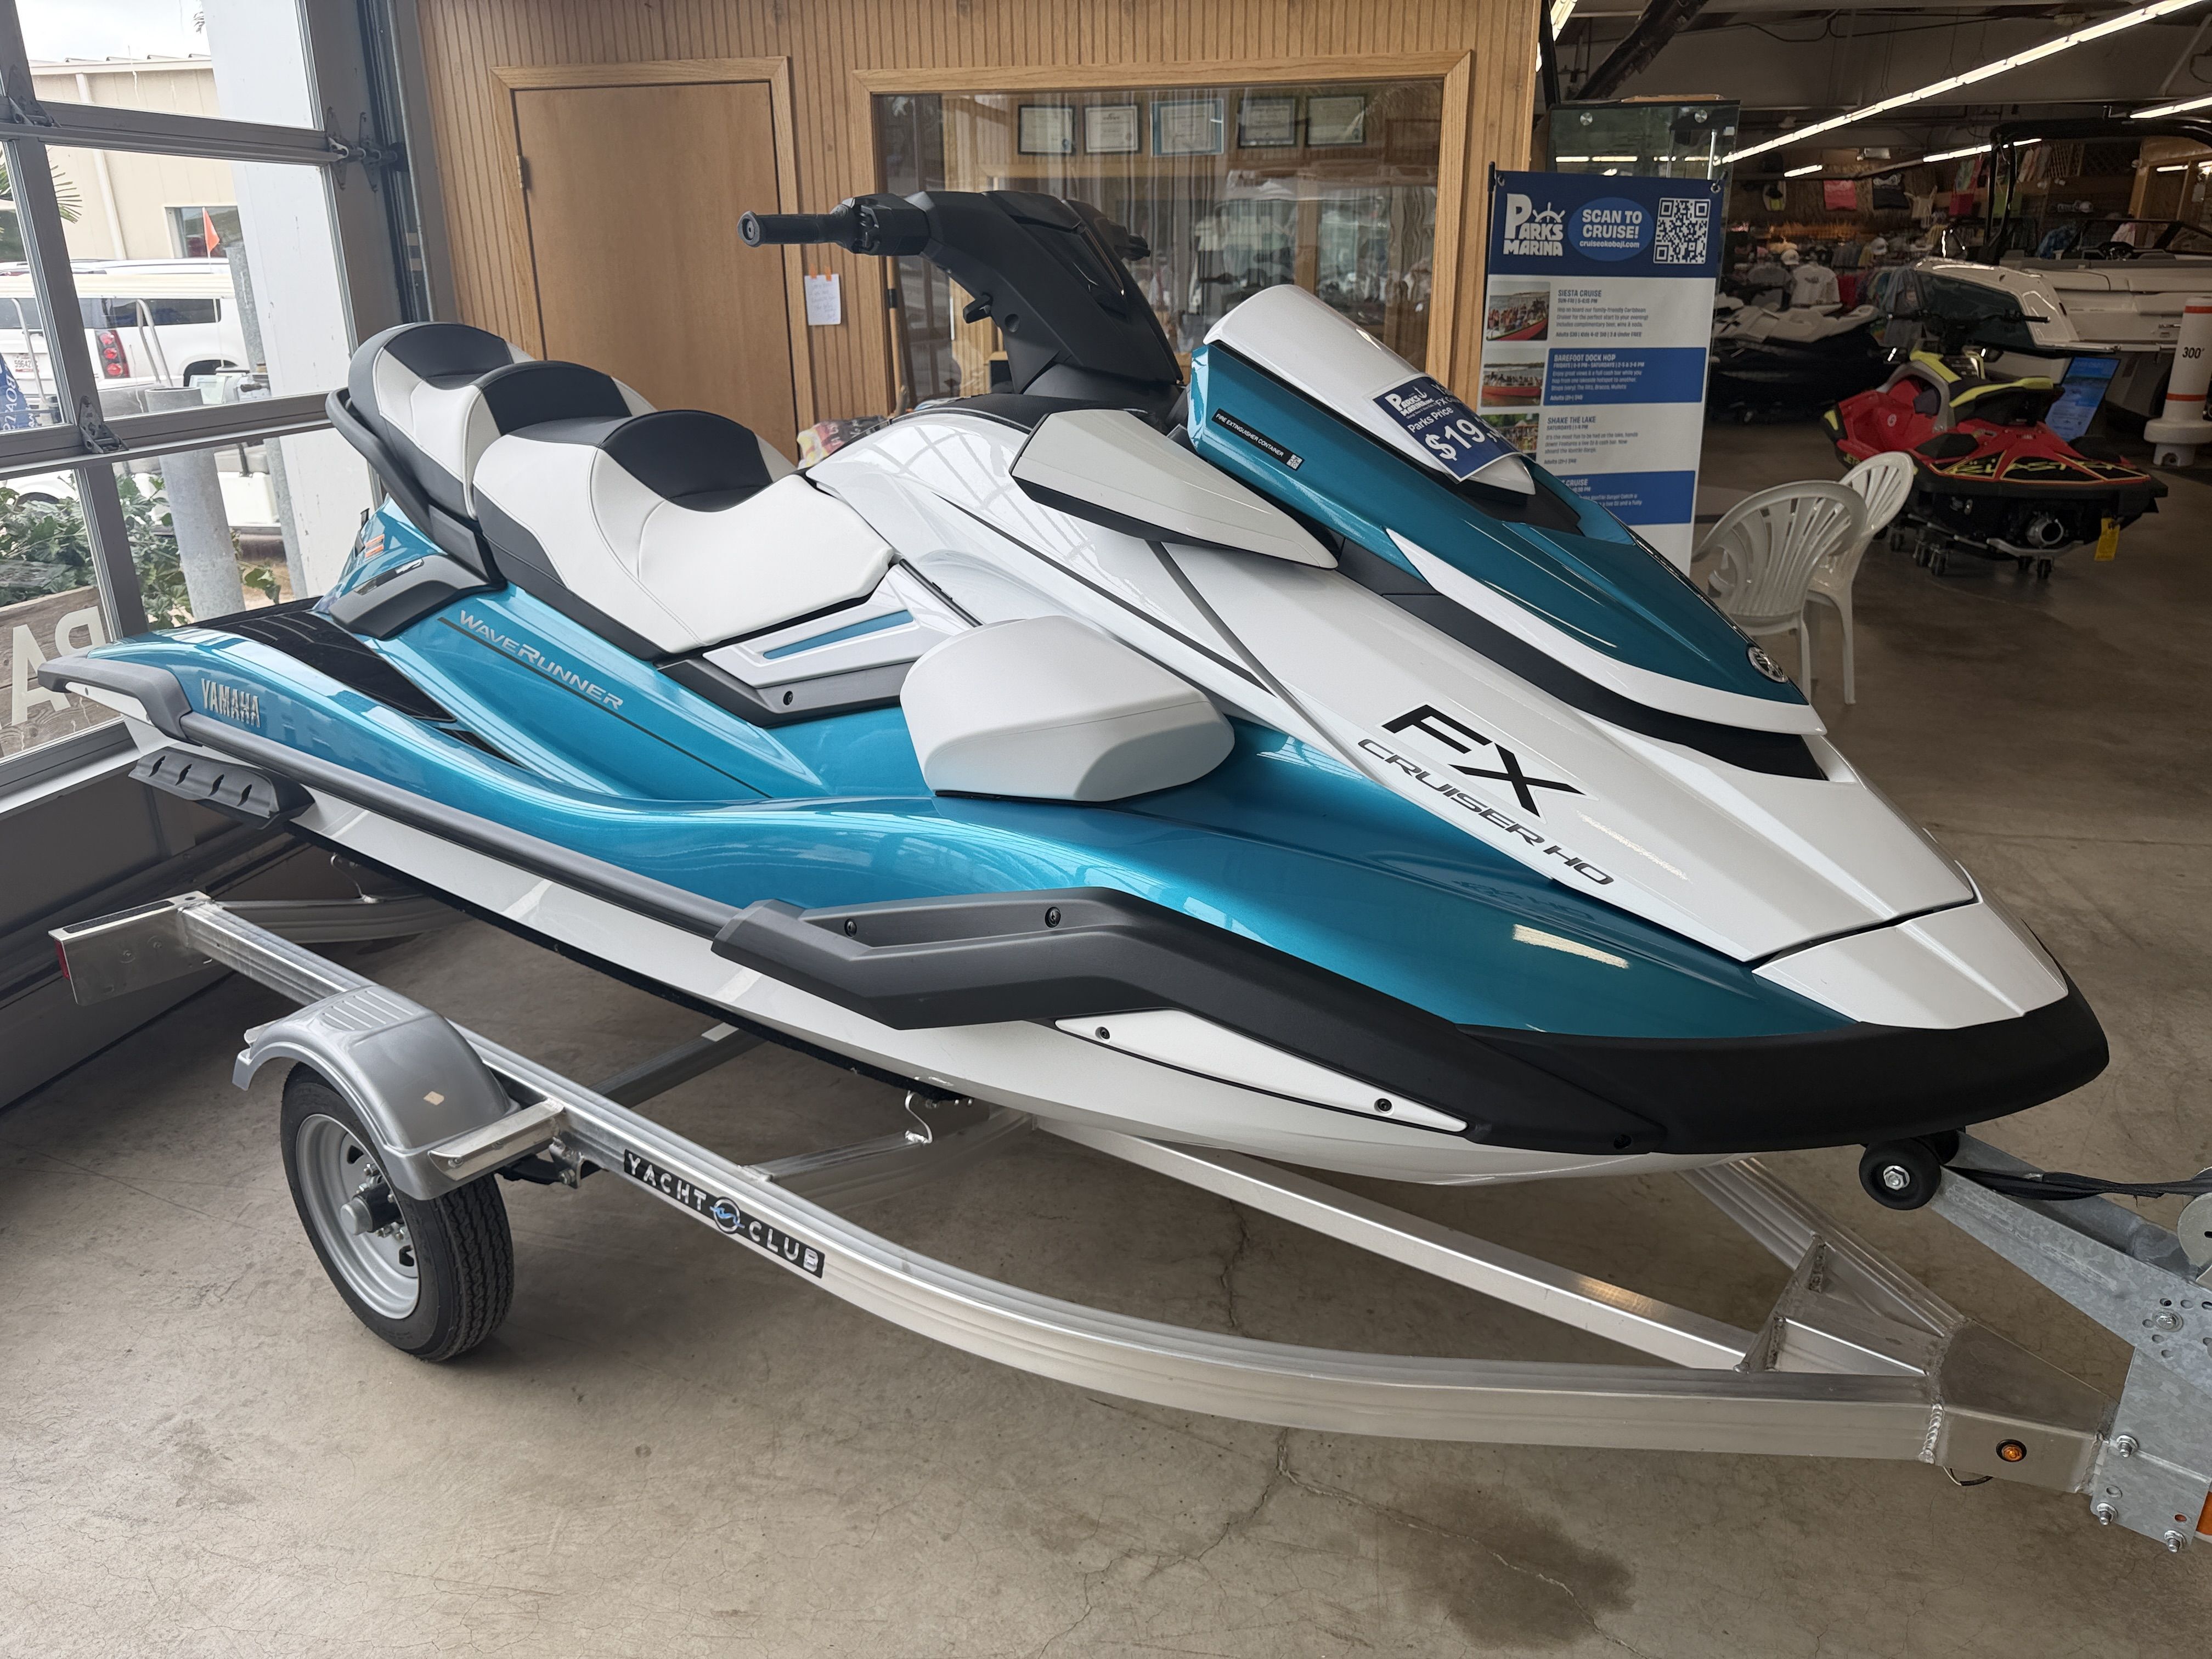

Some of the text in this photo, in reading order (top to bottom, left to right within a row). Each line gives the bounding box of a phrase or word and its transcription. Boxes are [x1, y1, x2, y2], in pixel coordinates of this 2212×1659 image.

[1504, 193, 1563, 240] PARKS
[1582, 209, 1642, 224] SCAN TO
[1583, 224, 1639, 239] CRUISE!
[1503, 240, 1563, 256] MARINA
[1579, 240, 1640, 249] cruiseokoboji.com
[1407, 416, 1434, 433] Parks
[1430, 407, 1454, 420] Price
[1435, 398, 1448, 407] FX
[1216, 413, 1284, 458] FIRE EXTINGUISHER CONTAINER
[201, 678, 261, 729] YAMAHA
[1381, 704, 1587, 818] FX
[1358, 738, 1614, 885] CRUISER HO
[628, 1153, 819, 1272] YACHT CLUB
